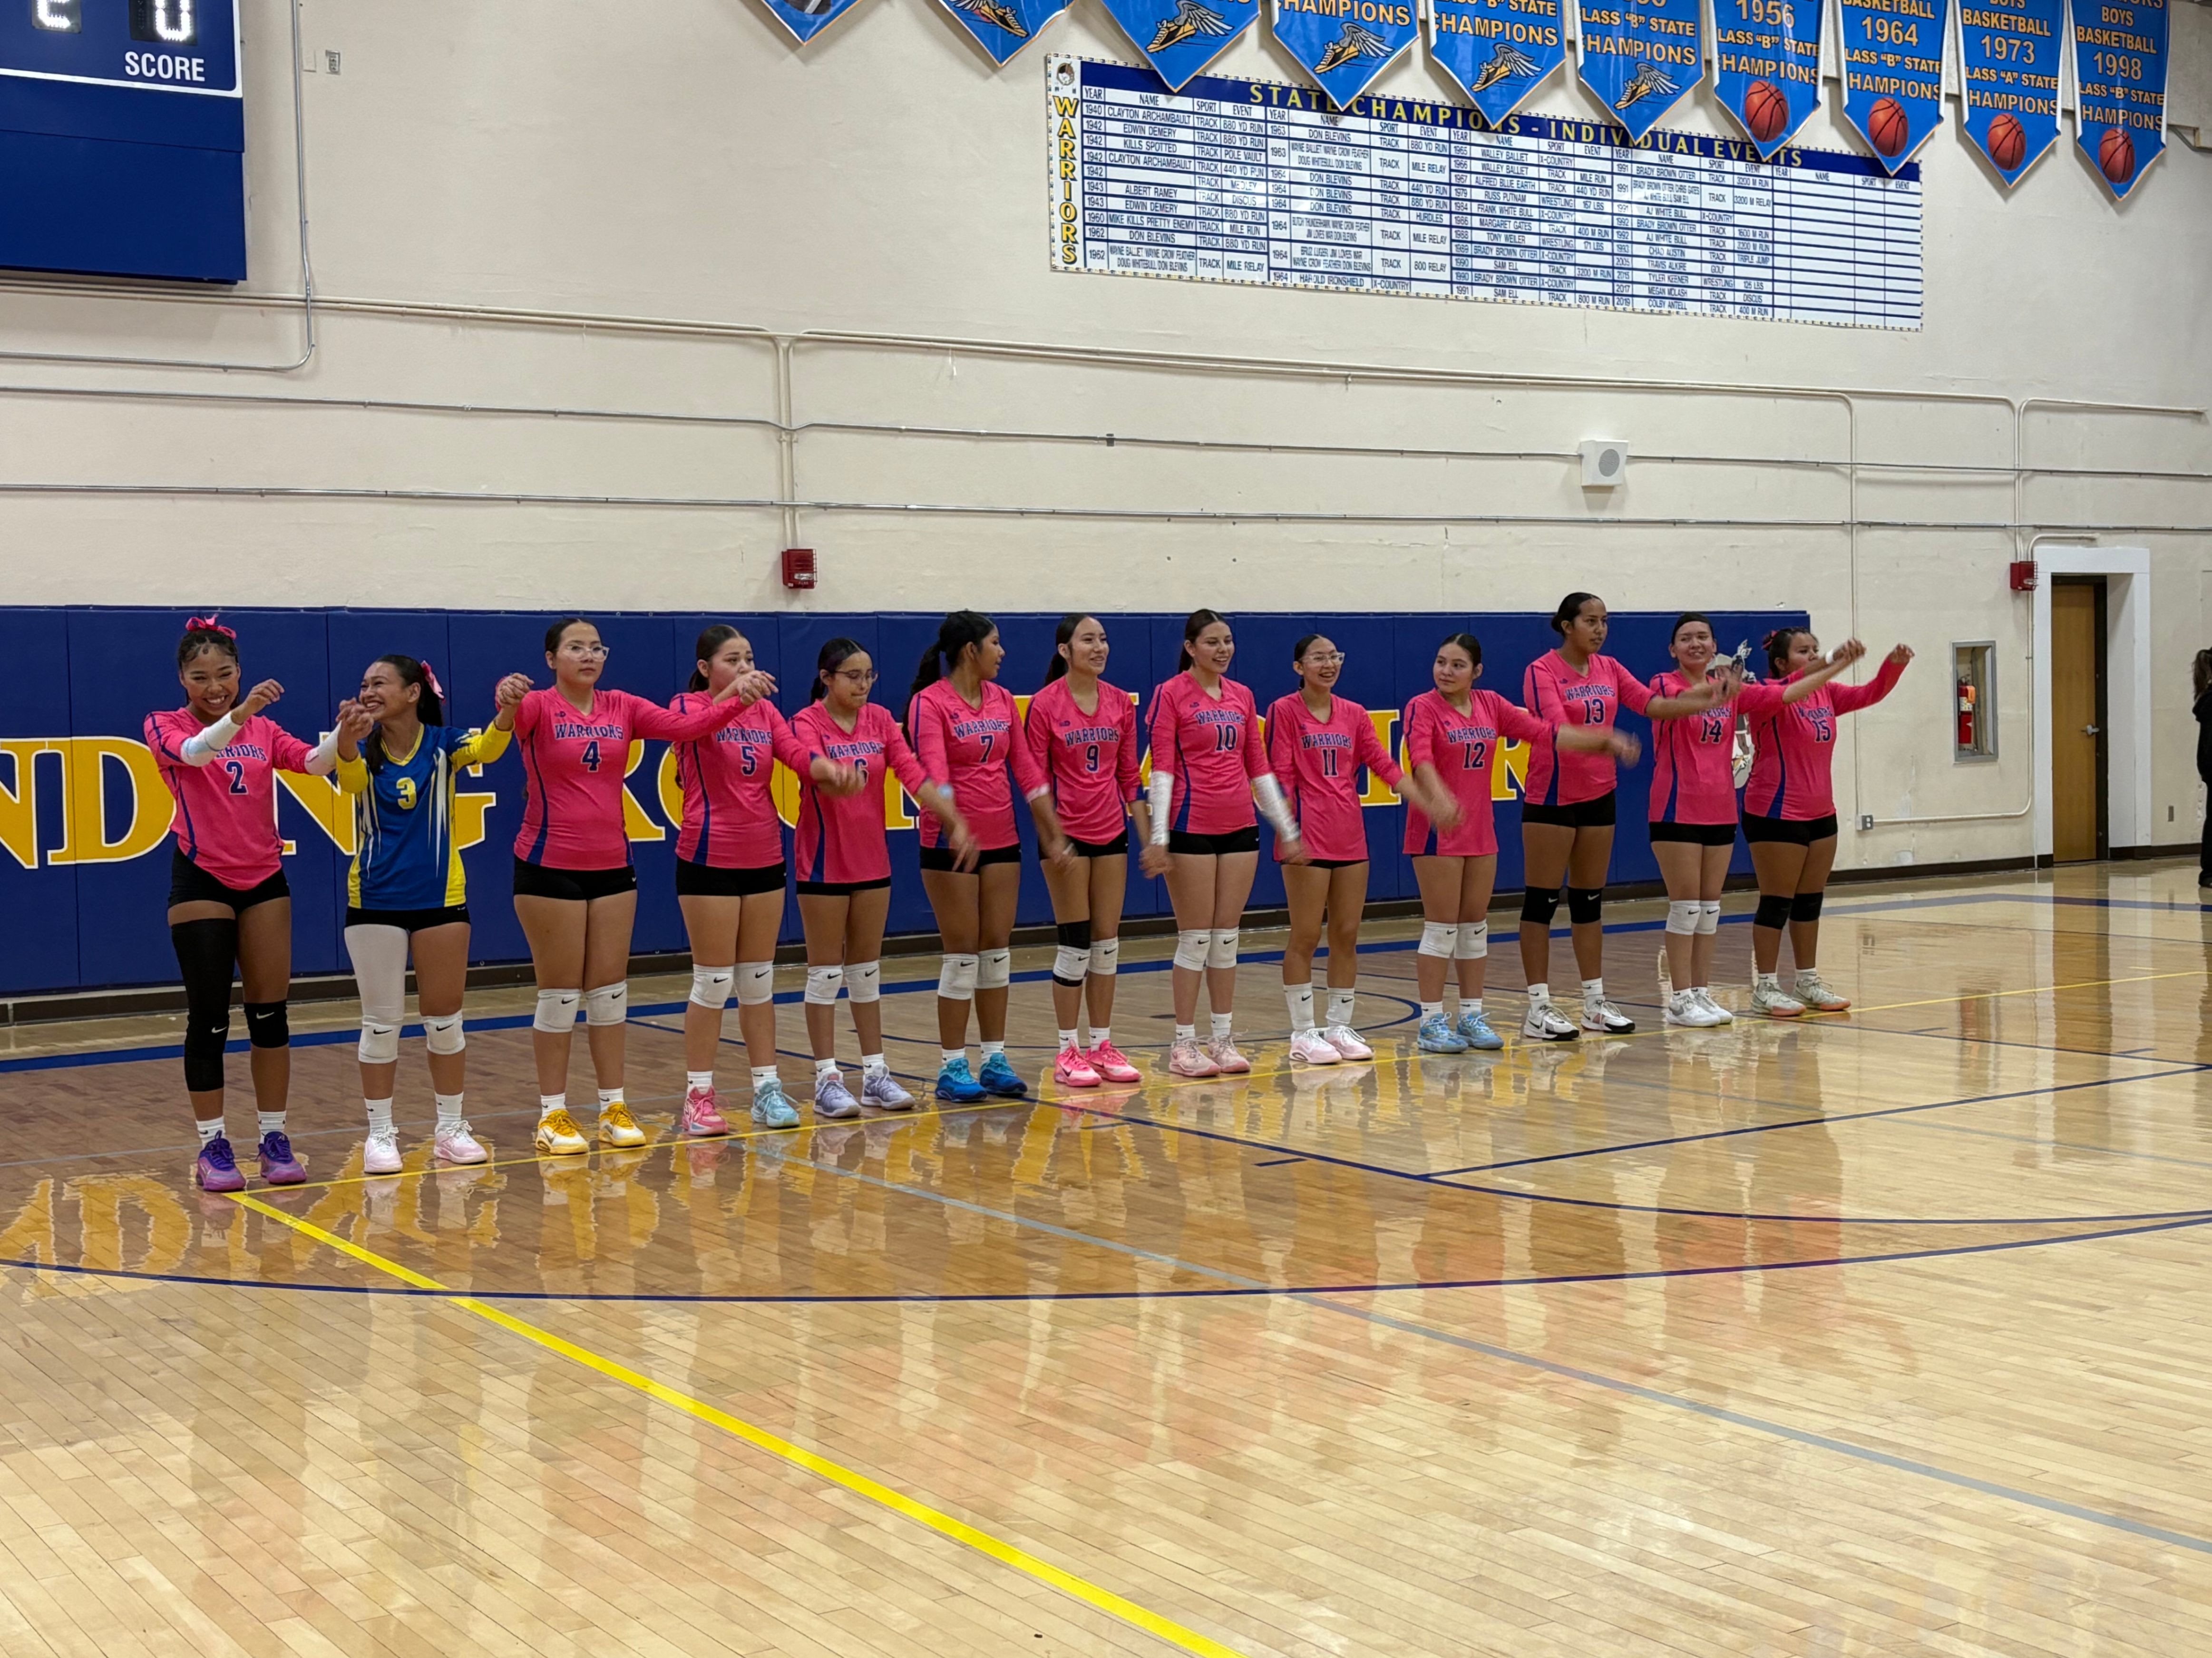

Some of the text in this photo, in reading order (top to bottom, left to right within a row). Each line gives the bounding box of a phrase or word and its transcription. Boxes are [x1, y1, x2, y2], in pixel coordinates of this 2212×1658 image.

[1278, 0, 1410, 25] HAMPIONS
[1509, 0, 1556, 16] STATE
[1736, 0, 1794, 28] 1956
[2102, 6, 2134, 27] BOYS
[1435, 13, 1558, 46] HAMPIONS
[1581, 8, 1620, 25] LASS
[1649, 18, 1695, 37] STATE
[1862, 16, 1918, 47] 1964
[1963, 8, 2051, 37] BASKETBALL
[1582, 34, 1696, 65] HAMPIONS
[1718, 29, 1754, 45] LASS
[1981, 35, 2035, 64] 1973
[2077, 26, 2157, 54] BASKETBALL
[125, 51, 205, 82] SCORE
[1722, 54, 1819, 84] HAMPIONS
[1845, 48, 1878, 65] LASS
[2094, 51, 2142, 80] 1998
[1849, 72, 1939, 100] HAMPIONS
[1966, 67, 1997, 82] LASS
[2021, 73, 2058, 89] STATE
[1085, 88, 1252, 116] YEAR NAME SPORT EVENT
[1969, 89, 2057, 116] HAMPIONS
[2079, 82, 2107, 97] LASS
[2131, 89, 2164, 106] STATE
[1086, 104, 1263, 133] 1940 CLAYTON ARCHAMBAULT TRACK 880 YD RUN
[1269, 109, 1437, 137] YEAR SPORT EVENT
[2083, 105, 2162, 131] HAMPIONS
[1086, 120, 1263, 147] 1942 EDWIN DEMERY TRACK 880 YD RUN
[1270, 126, 1400, 148] 1963 DON BLEVINS TRACK
[1453, 130, 1601, 155] YEAR EVENT
[1086, 135, 1262, 162] 1942 KILLS SPOTTED TRACK POLE VAULT
[1658, 154, 1674, 164] NAME
[1714, 147, 1802, 166] EVETS
[1086, 152, 1264, 177] 1942 CLAYTON ARCHAMBAULT TRACK 440 YD RUN
[1087, 166, 1103, 176] 1942
[1197, 176, 1219, 188] TRACK
[1412, 162, 1446, 174] MILE RELAY
[1548, 169, 1566, 179] TRACK
[1637, 166, 1696, 180] BRADY BROWN OTTER
[1052, 95, 1079, 264] WARRIORS
[1476, 176, 1497, 186] ALFRED
[1517, 180, 1535, 189] EARTH
[1087, 181, 1256, 206] 1943 ALBERT RAMEY TRACK DISCUS
[1484, 191, 1526, 202] RUSS PUTNAM
[1088, 213, 1260, 235] 1960 MIKE KILLS PRETTY ENEMY TRACK MILE RUN
[1416, 212, 1443, 223] HURDLES
[1480, 218, 1532, 231] MARGARET GATES
[1088, 228, 1265, 251] 1962 DON BLEVINS TRACK 880 YD RUN
[1487, 233, 1502, 241] TONY
[1374, 279, 1409, 290] X-COUNTRY
[1565, 684, 1615, 700] WARRIORS
[1583, 697, 1605, 725] 13
[555, 723, 624, 740] WARRIORS
[716, 727, 772, 745] WARRIORS
[1065, 727, 1119, 747] WARRIORS
[1216, 724, 1238, 752] 10
[1447, 727, 1497, 744] WARRIORS
[1700, 716, 1723, 744] 14
[1812, 719, 1831, 742] 15
[582, 741, 601, 772] 4
[741, 744, 756, 776] 5
[828, 741, 885, 759] WARRIORS
[980, 734, 994, 763] 7
[1086, 744, 1100, 773] 9
[1463, 742, 1486, 769] 12
[1322, 748, 1338, 777] 11
[225, 760, 248, 795] 2
[396, 777, 417, 810] 3
